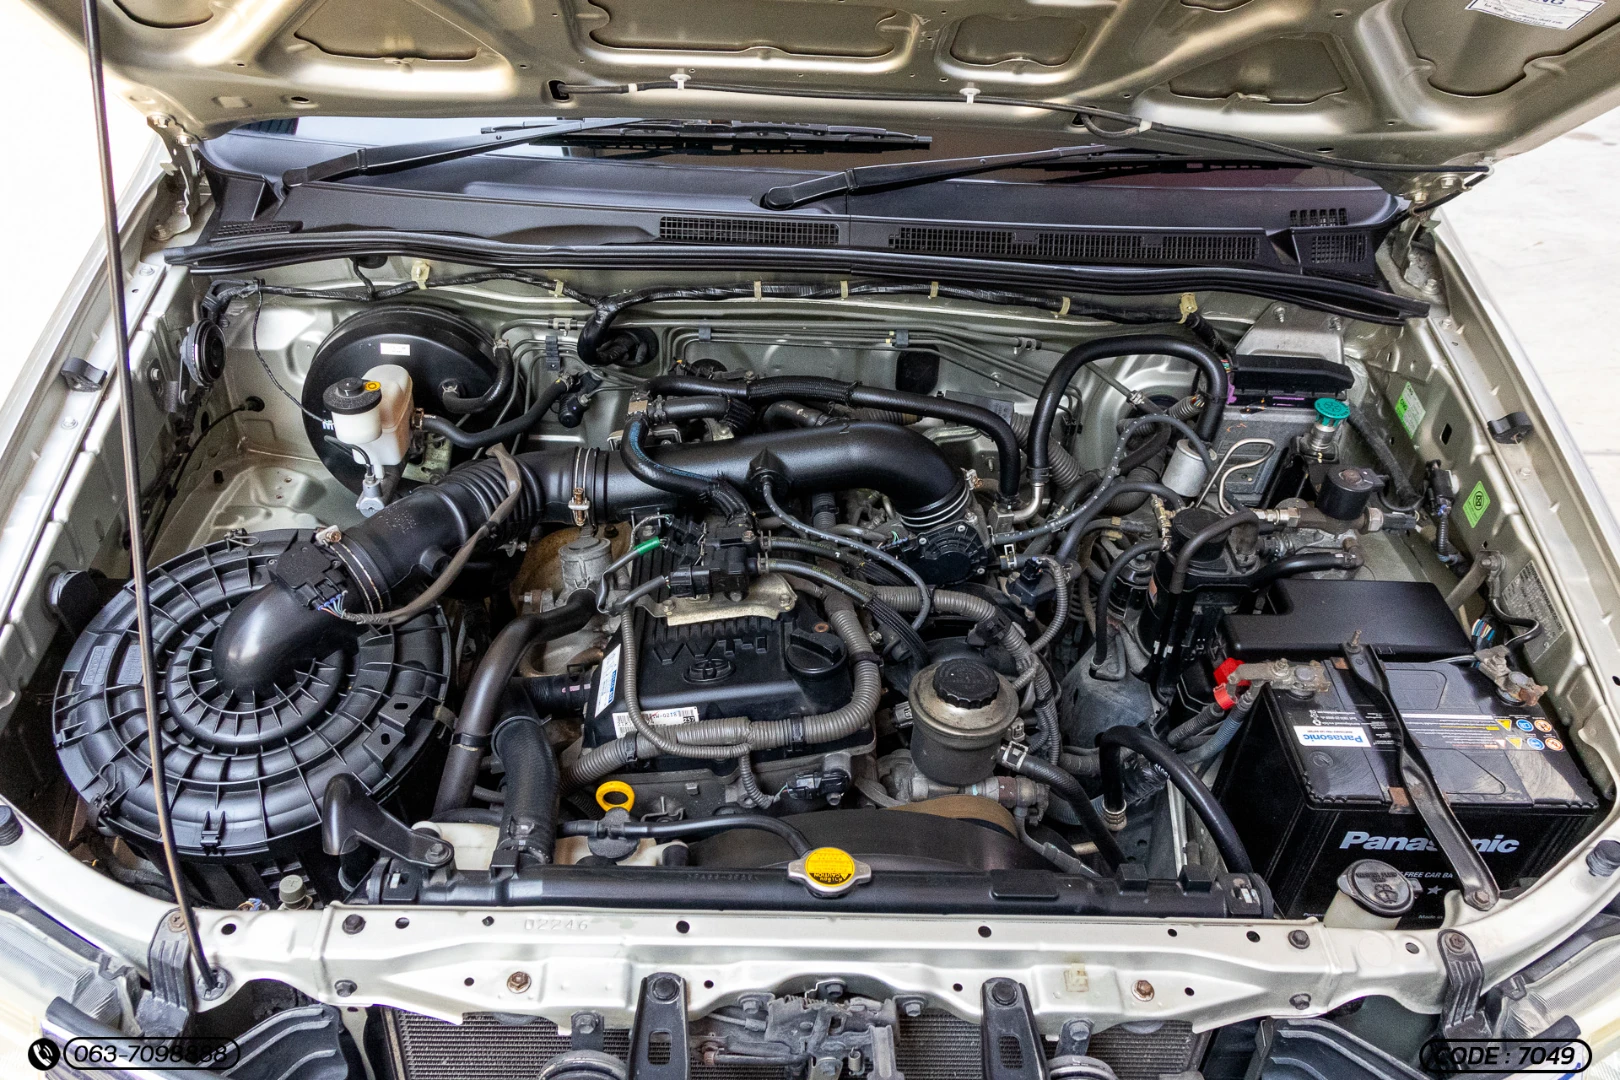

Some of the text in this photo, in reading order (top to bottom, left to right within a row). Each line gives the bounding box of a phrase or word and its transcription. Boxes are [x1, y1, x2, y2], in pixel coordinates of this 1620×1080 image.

[1303, 734, 1364, 743] Panasonic
[1339, 830, 1521, 853] Panasnic
[524, 918, 588, 930] 02246
